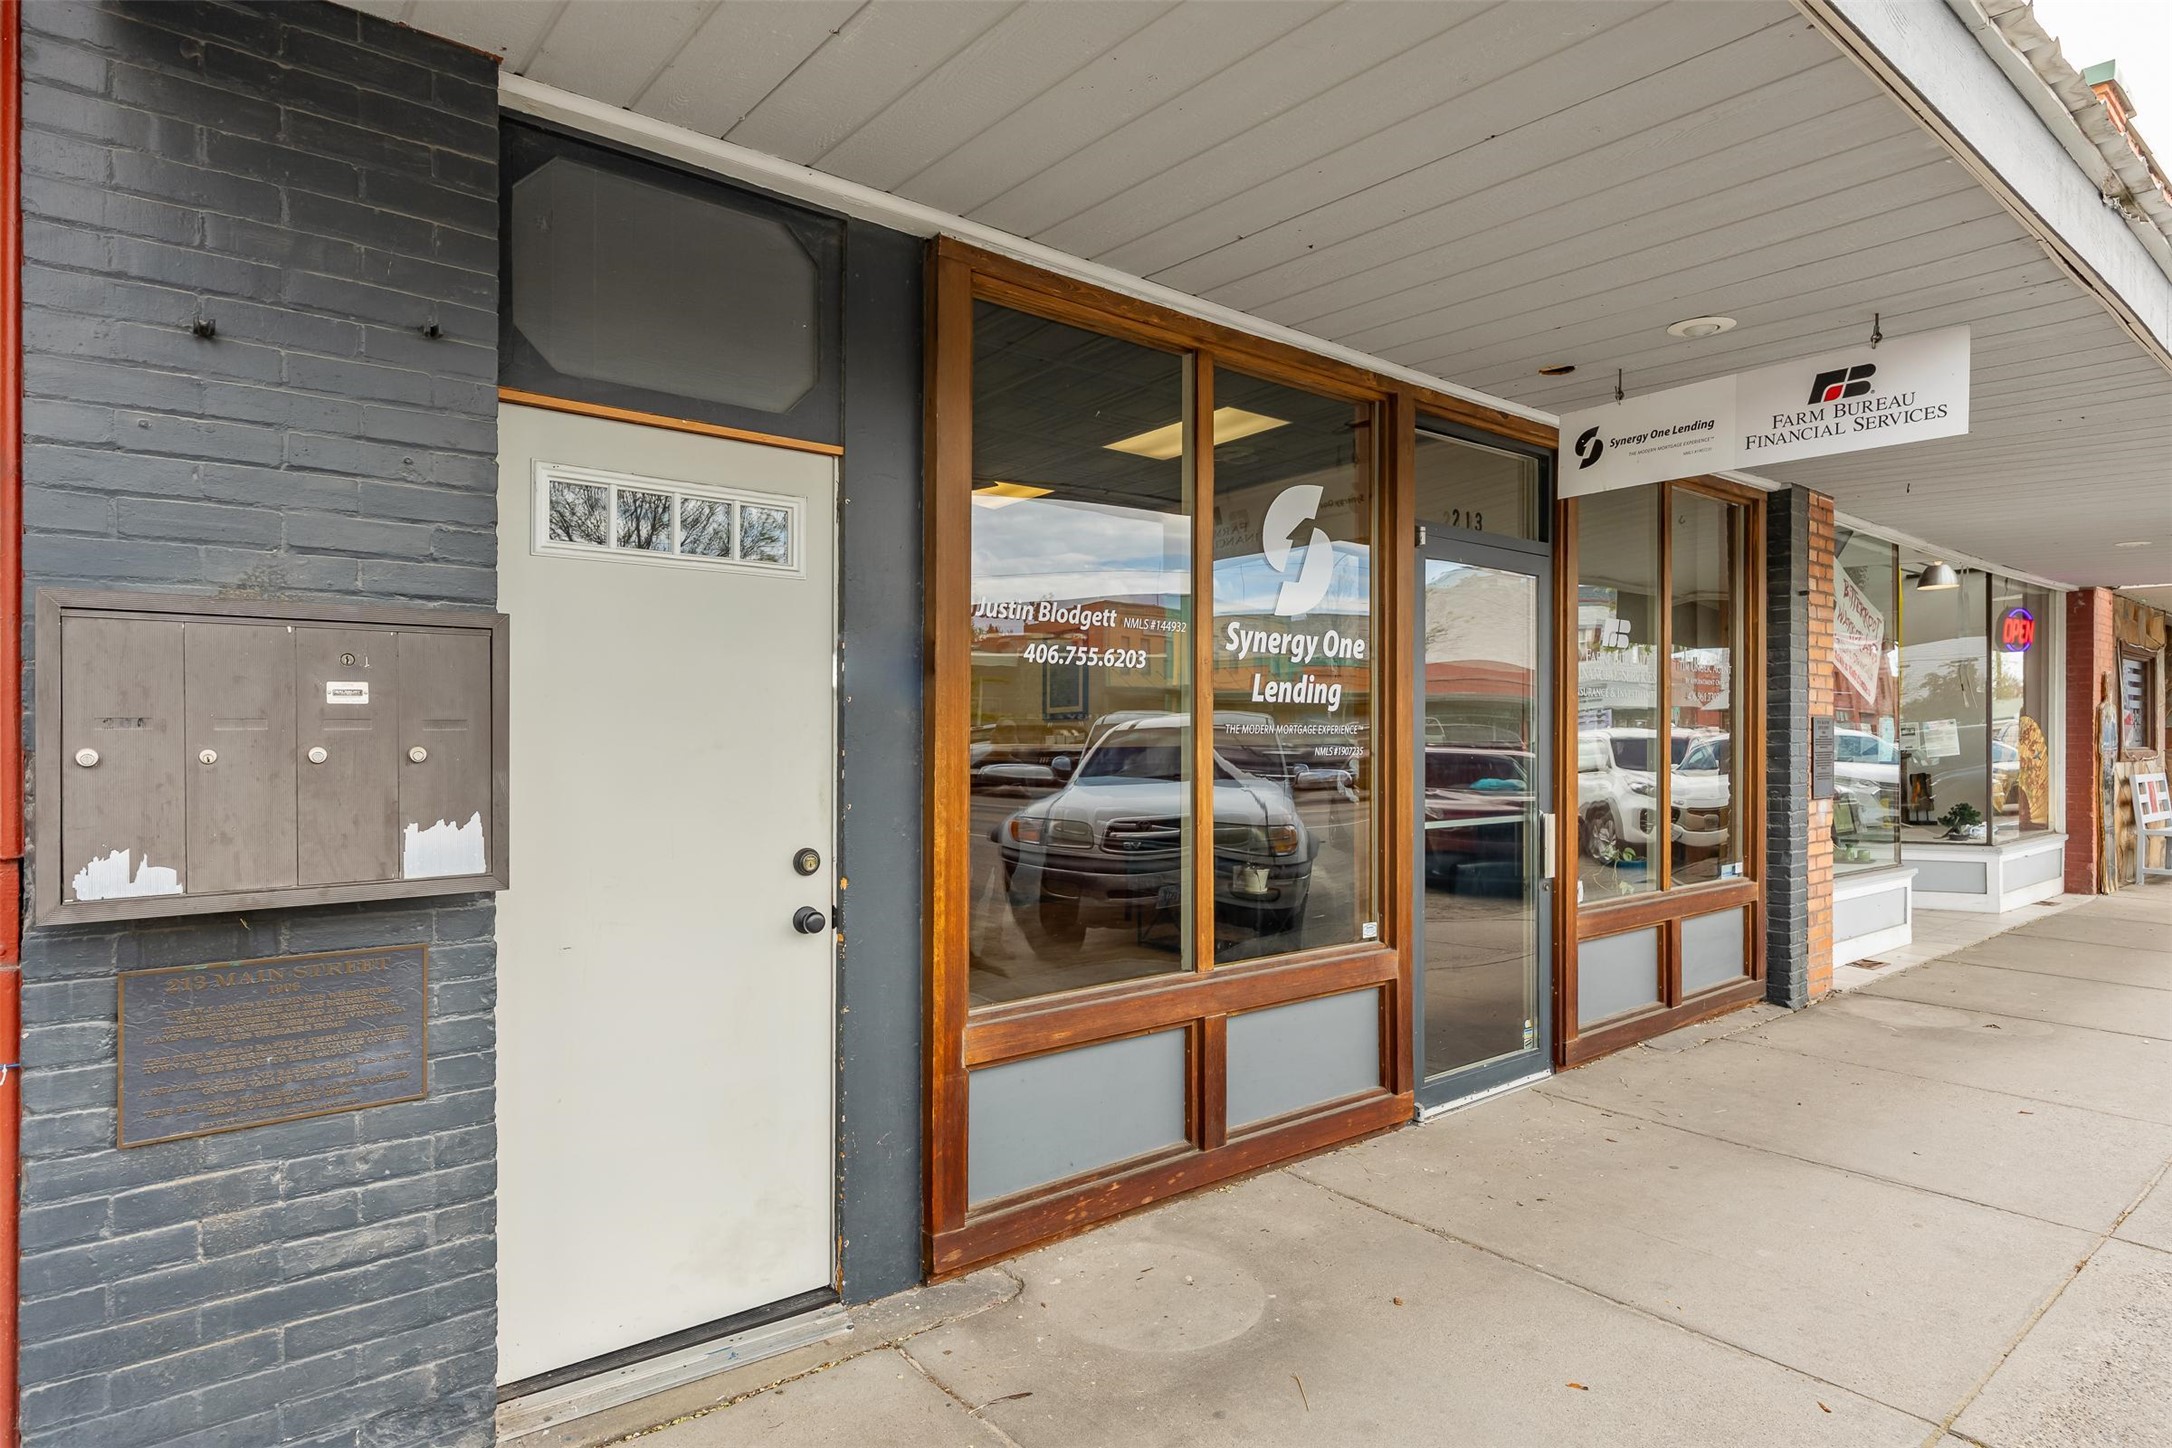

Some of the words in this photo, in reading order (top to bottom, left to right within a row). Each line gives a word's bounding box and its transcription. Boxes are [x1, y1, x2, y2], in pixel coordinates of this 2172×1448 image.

[1771, 408, 1825, 430] FARM
[1833, 391, 1916, 419] BUREAU
[1609, 431, 1649, 449] Synergy
[1650, 428, 1670, 439] One
[1672, 419, 1715, 435] Lending
[1745, 422, 1846, 450] FINANCIAL
[1853, 404, 1949, 432] SERVICES
[1451, 509, 1483, 531] 213
[974, 596, 1034, 621] Justin
[1038, 601, 1117, 631] Blodgett
[1123, 617, 1149, 631] NMLS
[1150, 620, 1187, 633] #144932
[2003, 617, 2035, 644] OPEN
[1023, 643, 1147, 669] 406.755.6203
[1225, 621, 1319, 664] Synergy
[1322, 630, 1366, 659] One
[1251, 673, 1342, 712] Lending
[1225, 723, 1240, 734] THE
[1241, 724, 1275, 734] MODERN
[1276, 724, 1317, 735] MORTGAGE
[1315, 746, 1333, 756] NMLS
[165, 975, 206, 992] 213
[214, 967, 283, 987] MAIN
[292, 957, 391, 979] STREET
